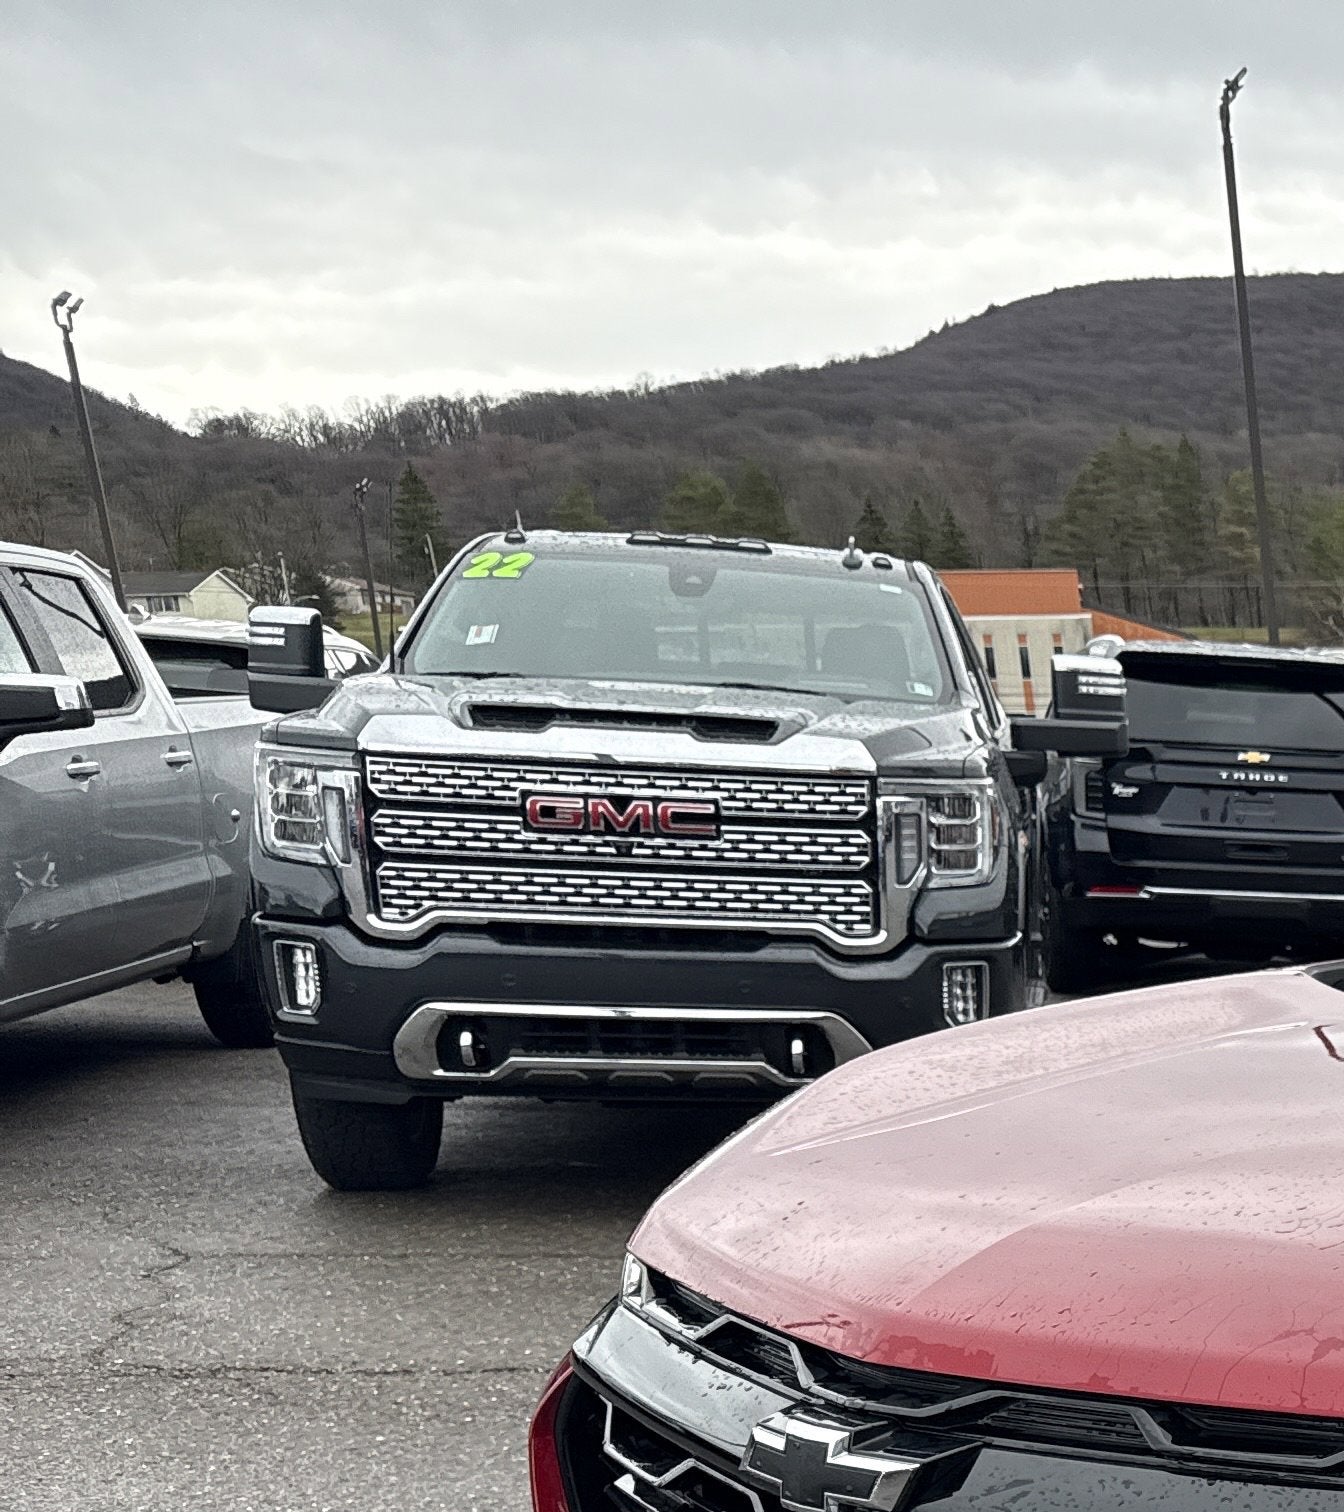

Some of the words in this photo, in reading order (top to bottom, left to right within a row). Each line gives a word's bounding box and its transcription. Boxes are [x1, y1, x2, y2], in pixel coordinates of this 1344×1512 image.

[463, 552, 535, 578] 22
[1219, 771, 1289, 782] TAHOE
[526, 796, 717, 836] GMC
